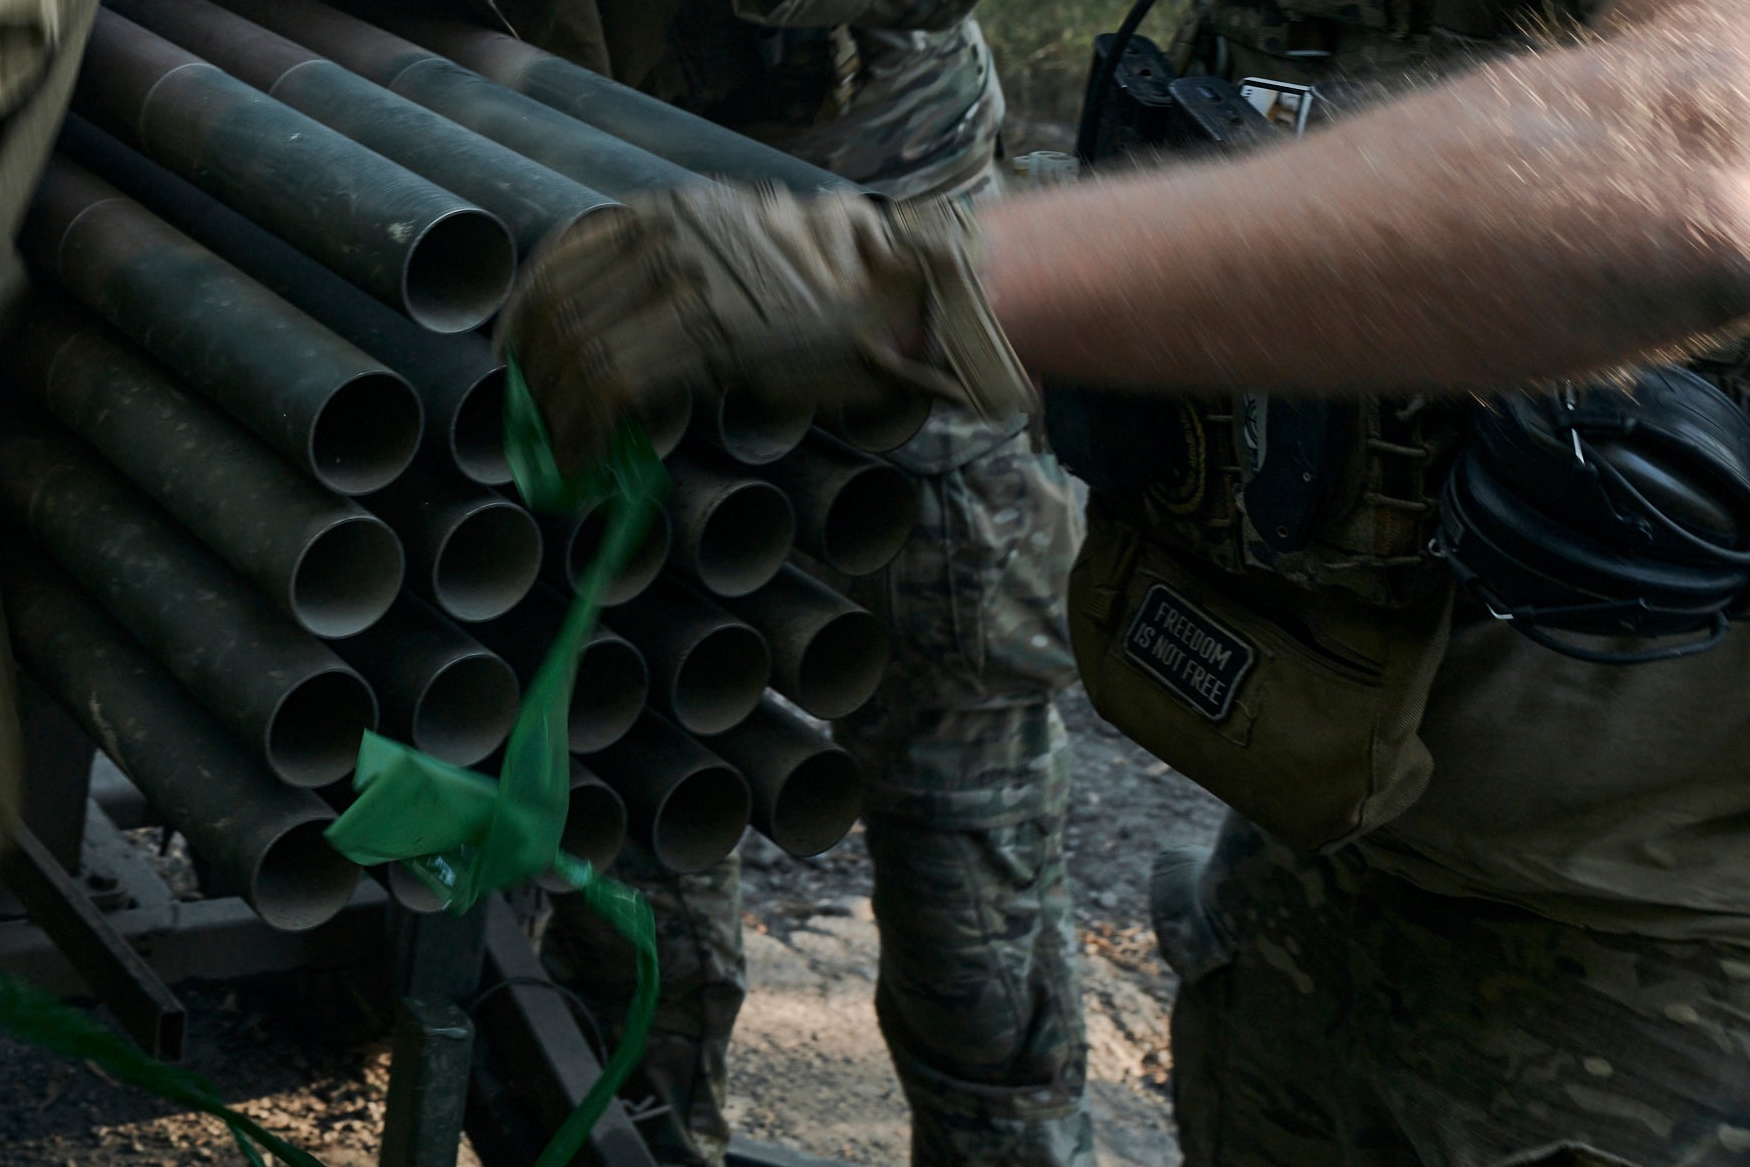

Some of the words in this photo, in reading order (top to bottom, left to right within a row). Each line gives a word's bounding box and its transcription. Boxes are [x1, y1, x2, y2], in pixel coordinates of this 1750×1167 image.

[1133, 622, 1156, 648] IS
[1151, 635, 1186, 672] NOT
[1182, 659, 1226, 705] FREE
[1154, 601, 1232, 671] FREEDOM
